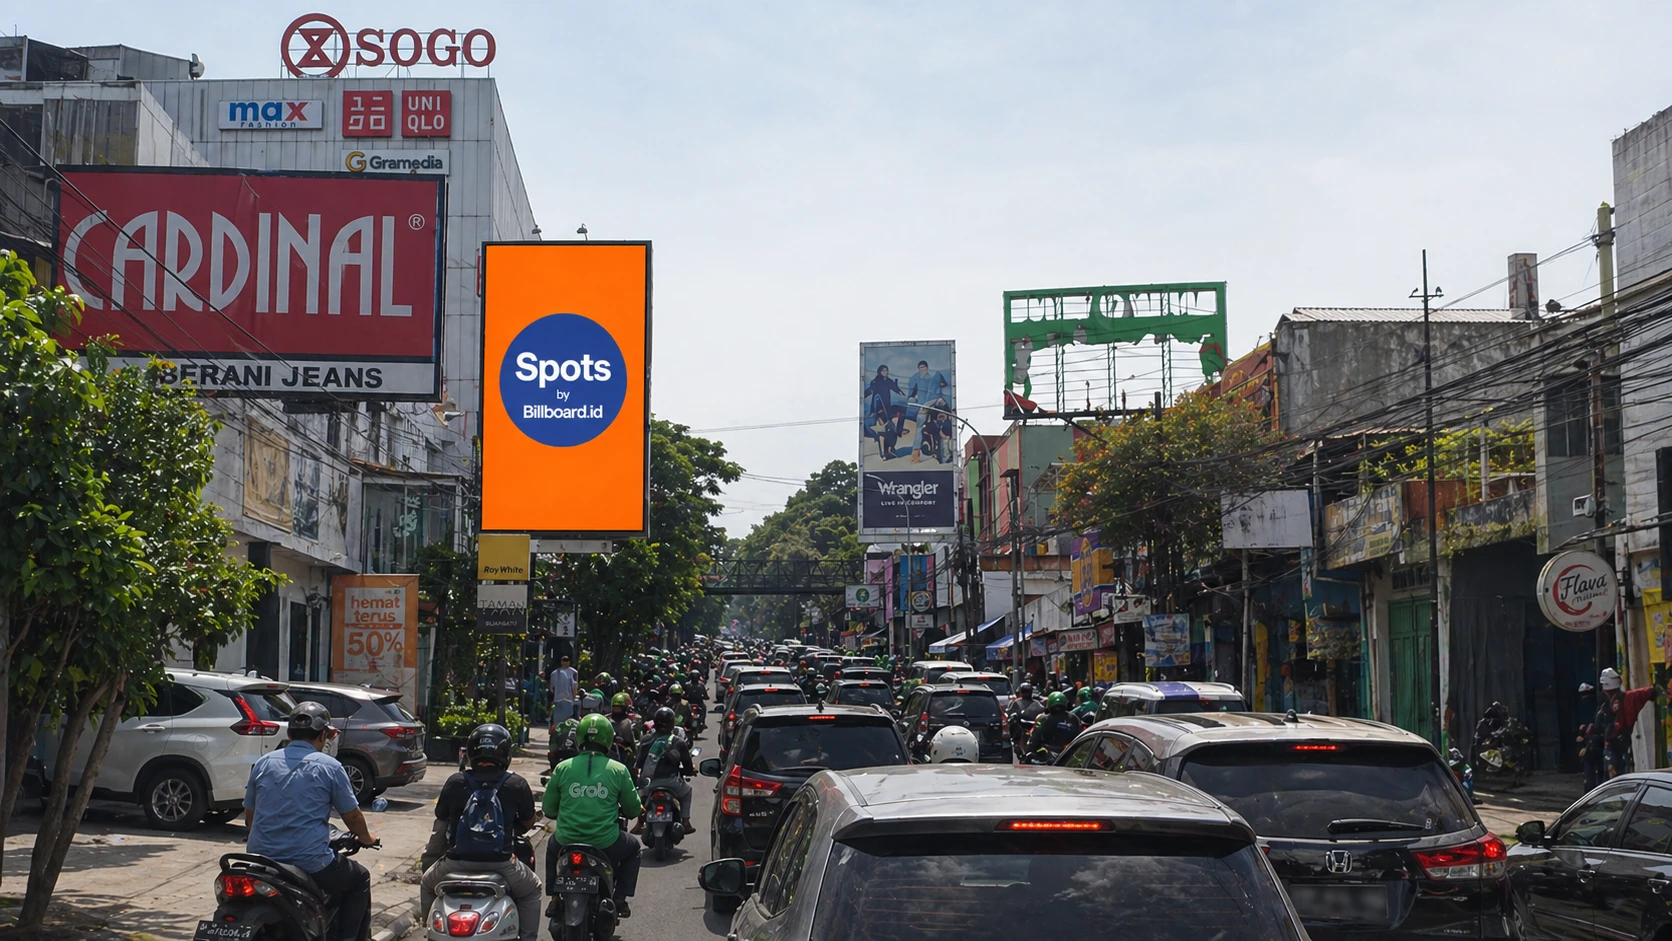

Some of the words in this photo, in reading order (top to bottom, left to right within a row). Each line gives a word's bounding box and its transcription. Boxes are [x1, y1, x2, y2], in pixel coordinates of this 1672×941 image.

[356, 28, 496, 67] SOGO
[229, 101, 309, 122] max
[407, 96, 442, 111] UNI
[407, 114, 446, 133] QLO
[369, 155, 444, 171] Gramedia
[63, 208, 413, 317] CARDINAL
[159, 361, 271, 388] BERANI
[281, 366, 383, 389] JEANS
[515, 351, 612, 388] Spots
[556, 389, 571, 402] by
[523, 405, 604, 419] Billboard.id
[877, 480, 939, 499] Wrangler
[500, 565, 524, 574] White
[1560, 573, 1608, 600] Flava
[350, 595, 401, 609] hemat
[353, 610, 397, 623] terus
[346, 630, 405, 657] 50%
[568, 782, 609, 799] Grab
